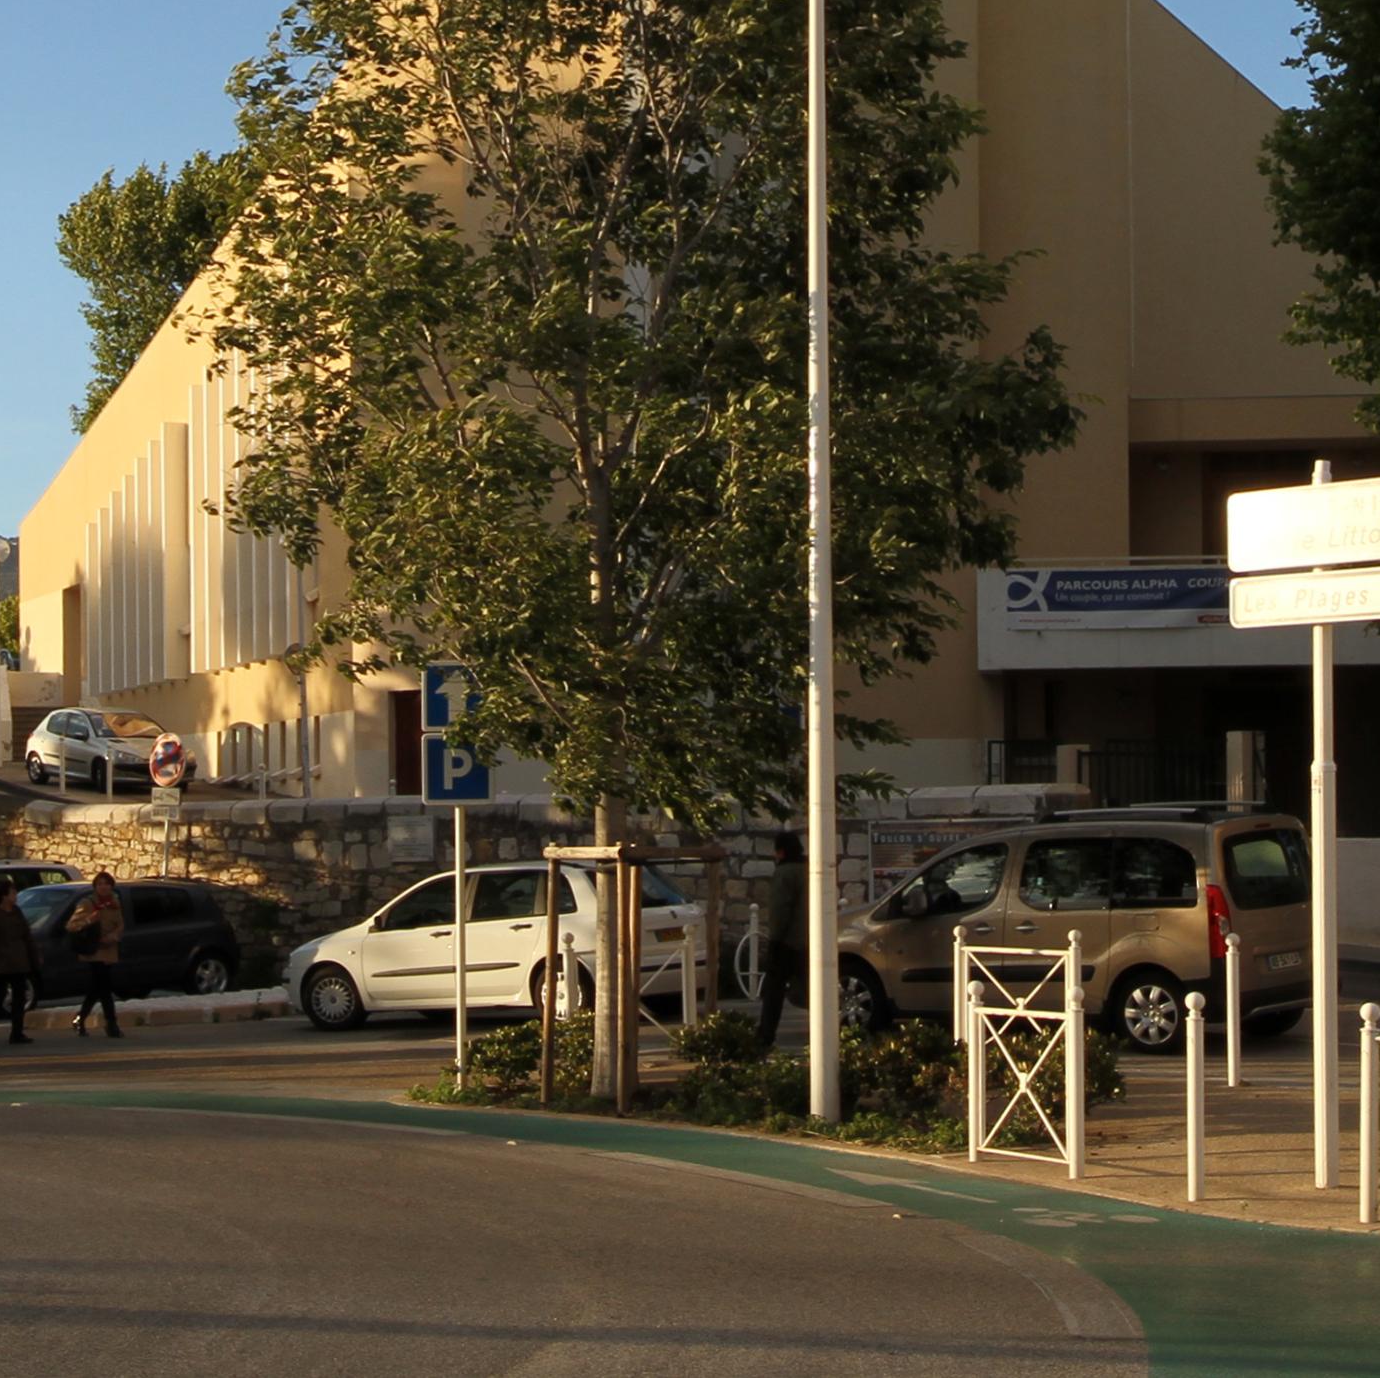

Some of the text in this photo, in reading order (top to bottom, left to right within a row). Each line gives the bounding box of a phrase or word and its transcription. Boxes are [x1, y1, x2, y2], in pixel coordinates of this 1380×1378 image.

[1055, 579, 1129, 591] PARCOURS
[1130, 578, 1179, 591] ALPHA
[1055, 592, 1069, 602] Un
[1243, 588, 1370, 614] Les Plages
[443, 748, 473, 791] P
